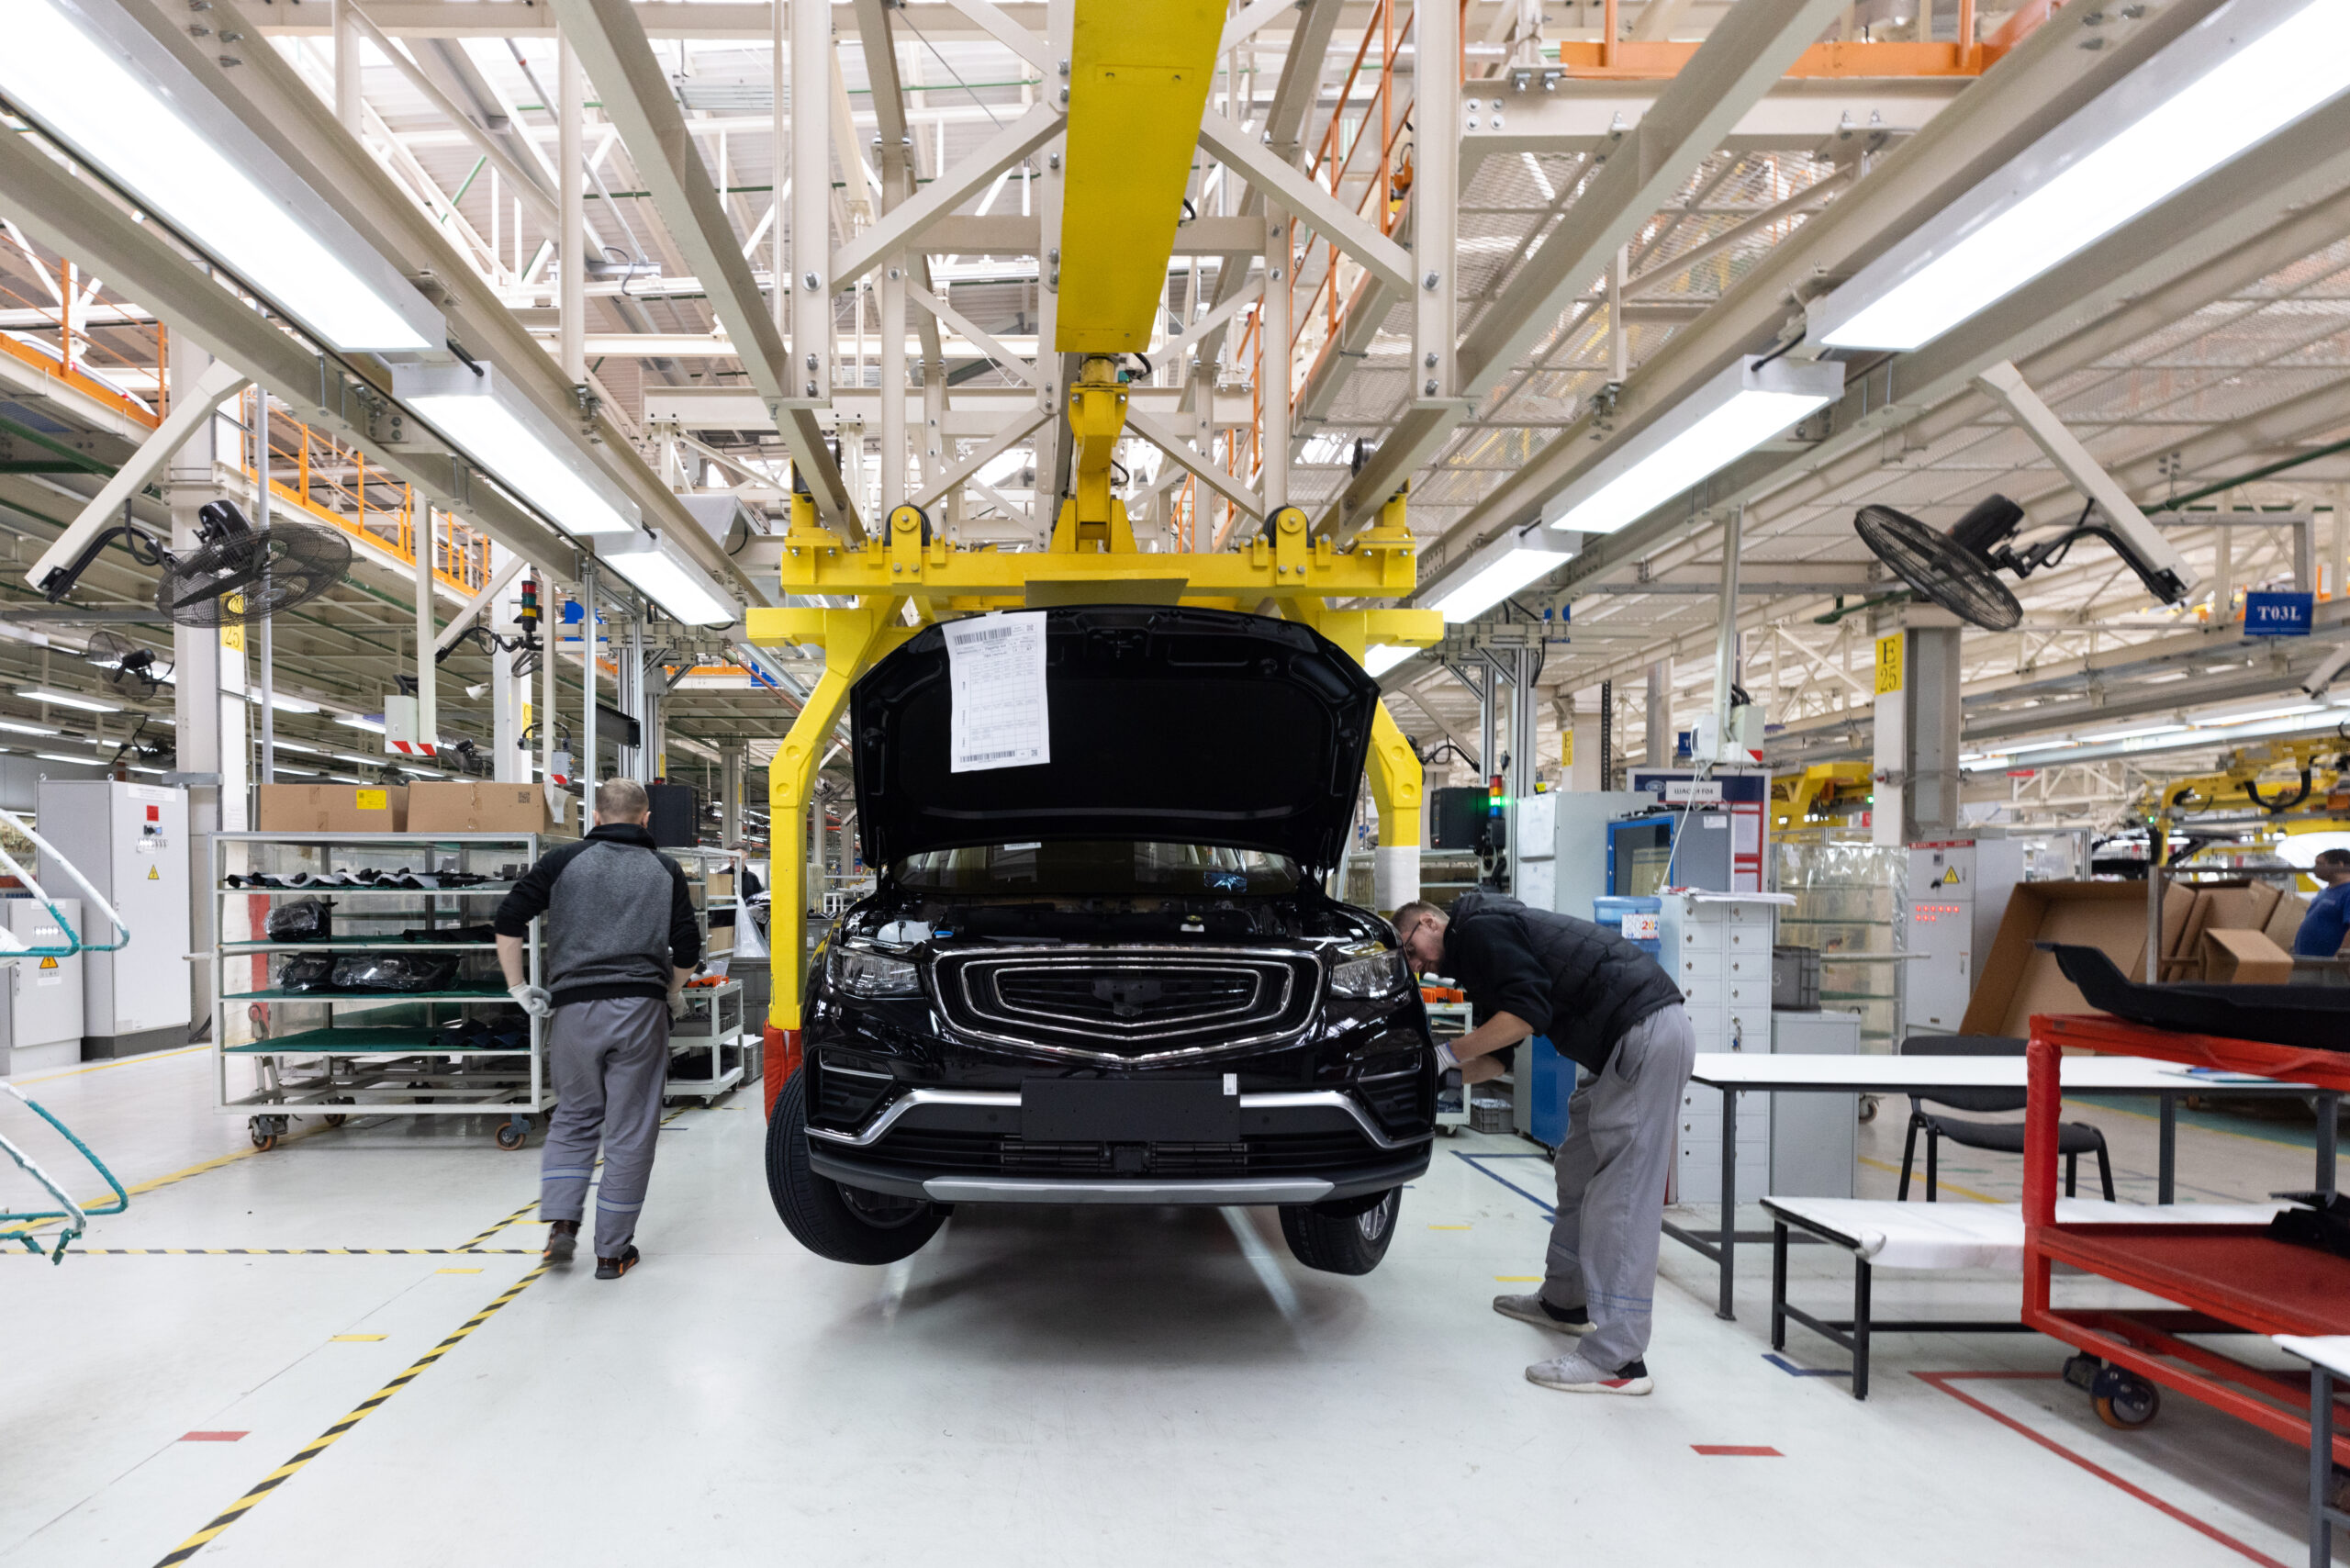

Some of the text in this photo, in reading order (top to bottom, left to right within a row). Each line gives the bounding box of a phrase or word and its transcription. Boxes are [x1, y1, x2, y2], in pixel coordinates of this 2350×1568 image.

[2257, 606, 2301, 621] T03L
[1884, 638, 1896, 665] E
[1880, 666, 1897, 692] 25
